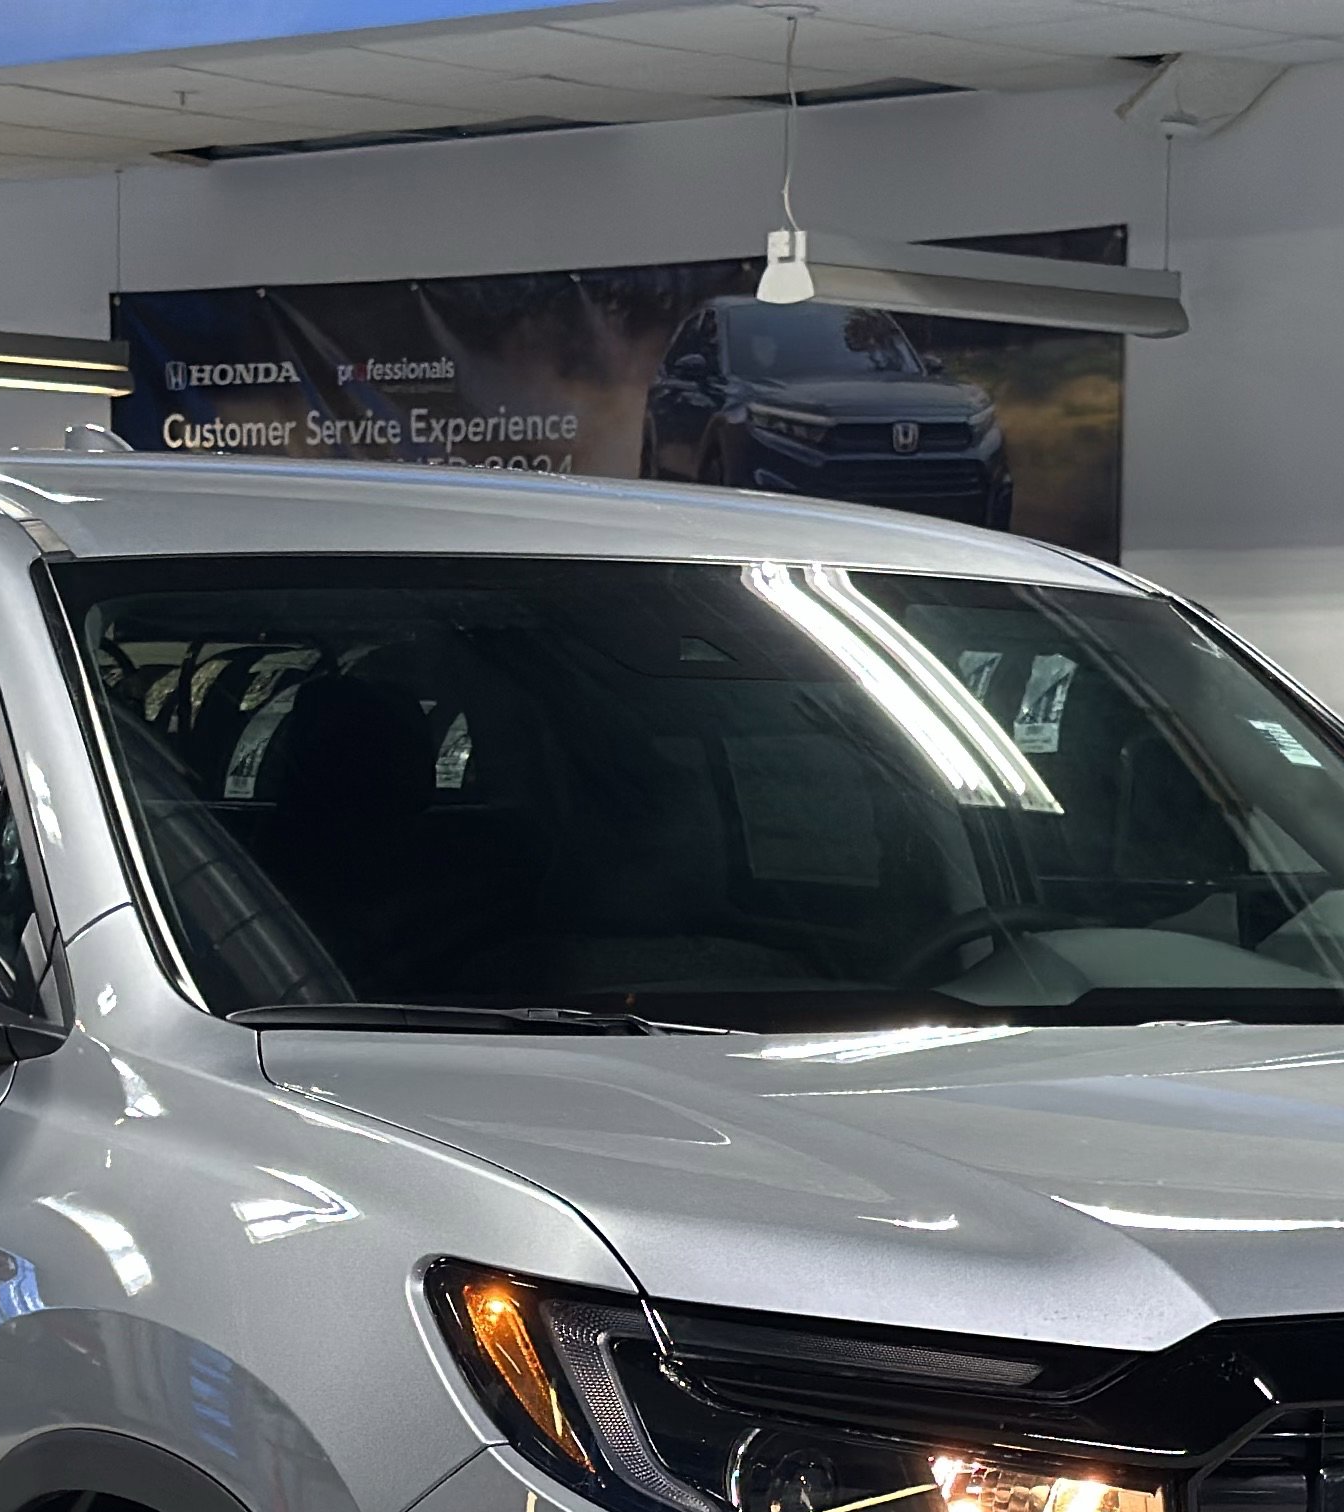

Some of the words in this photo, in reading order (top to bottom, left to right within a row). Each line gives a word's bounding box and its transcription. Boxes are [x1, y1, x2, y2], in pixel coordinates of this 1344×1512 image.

[188, 361, 301, 386] HONDA
[163, 413, 297, 449] Customer
[306, 409, 401, 446] Service
[410, 406, 578, 453] Experience
